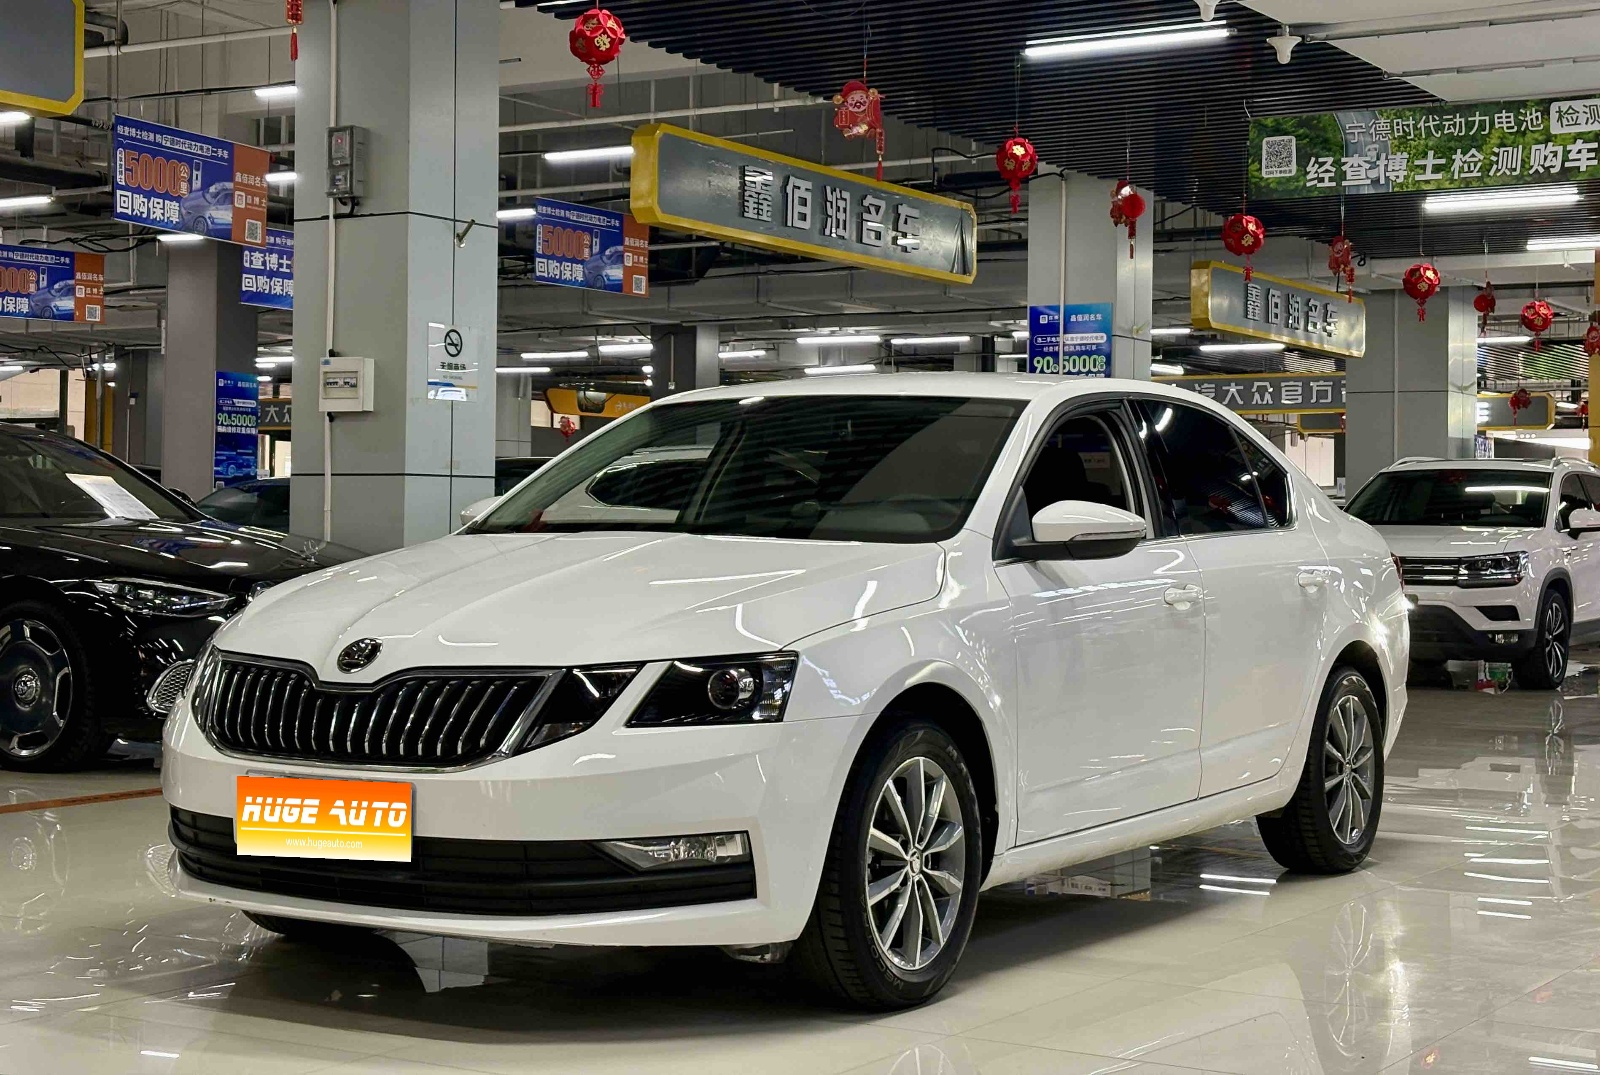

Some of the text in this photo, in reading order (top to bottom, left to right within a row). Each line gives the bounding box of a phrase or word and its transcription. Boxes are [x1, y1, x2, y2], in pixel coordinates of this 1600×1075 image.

[1345, 102, 1600, 144] 宁德时代动力电池 检测
[125, 149, 180, 196] 5000
[178, 162, 190, 198] 公里
[1306, 138, 1599, 188] 经查博士检测购车
[116, 189, 180, 224] 回购保障
[741, 165, 921, 253] 鑫佰润名车
[542, 224, 585, 260] 5000
[250, 251, 292, 273] 查博士
[535, 258, 584, 282] 回购保障
[242, 273, 294, 297] 回购保障
[0, 296, 29, 314] 保障
[1245, 283, 1339, 337] 鑫佰润名车
